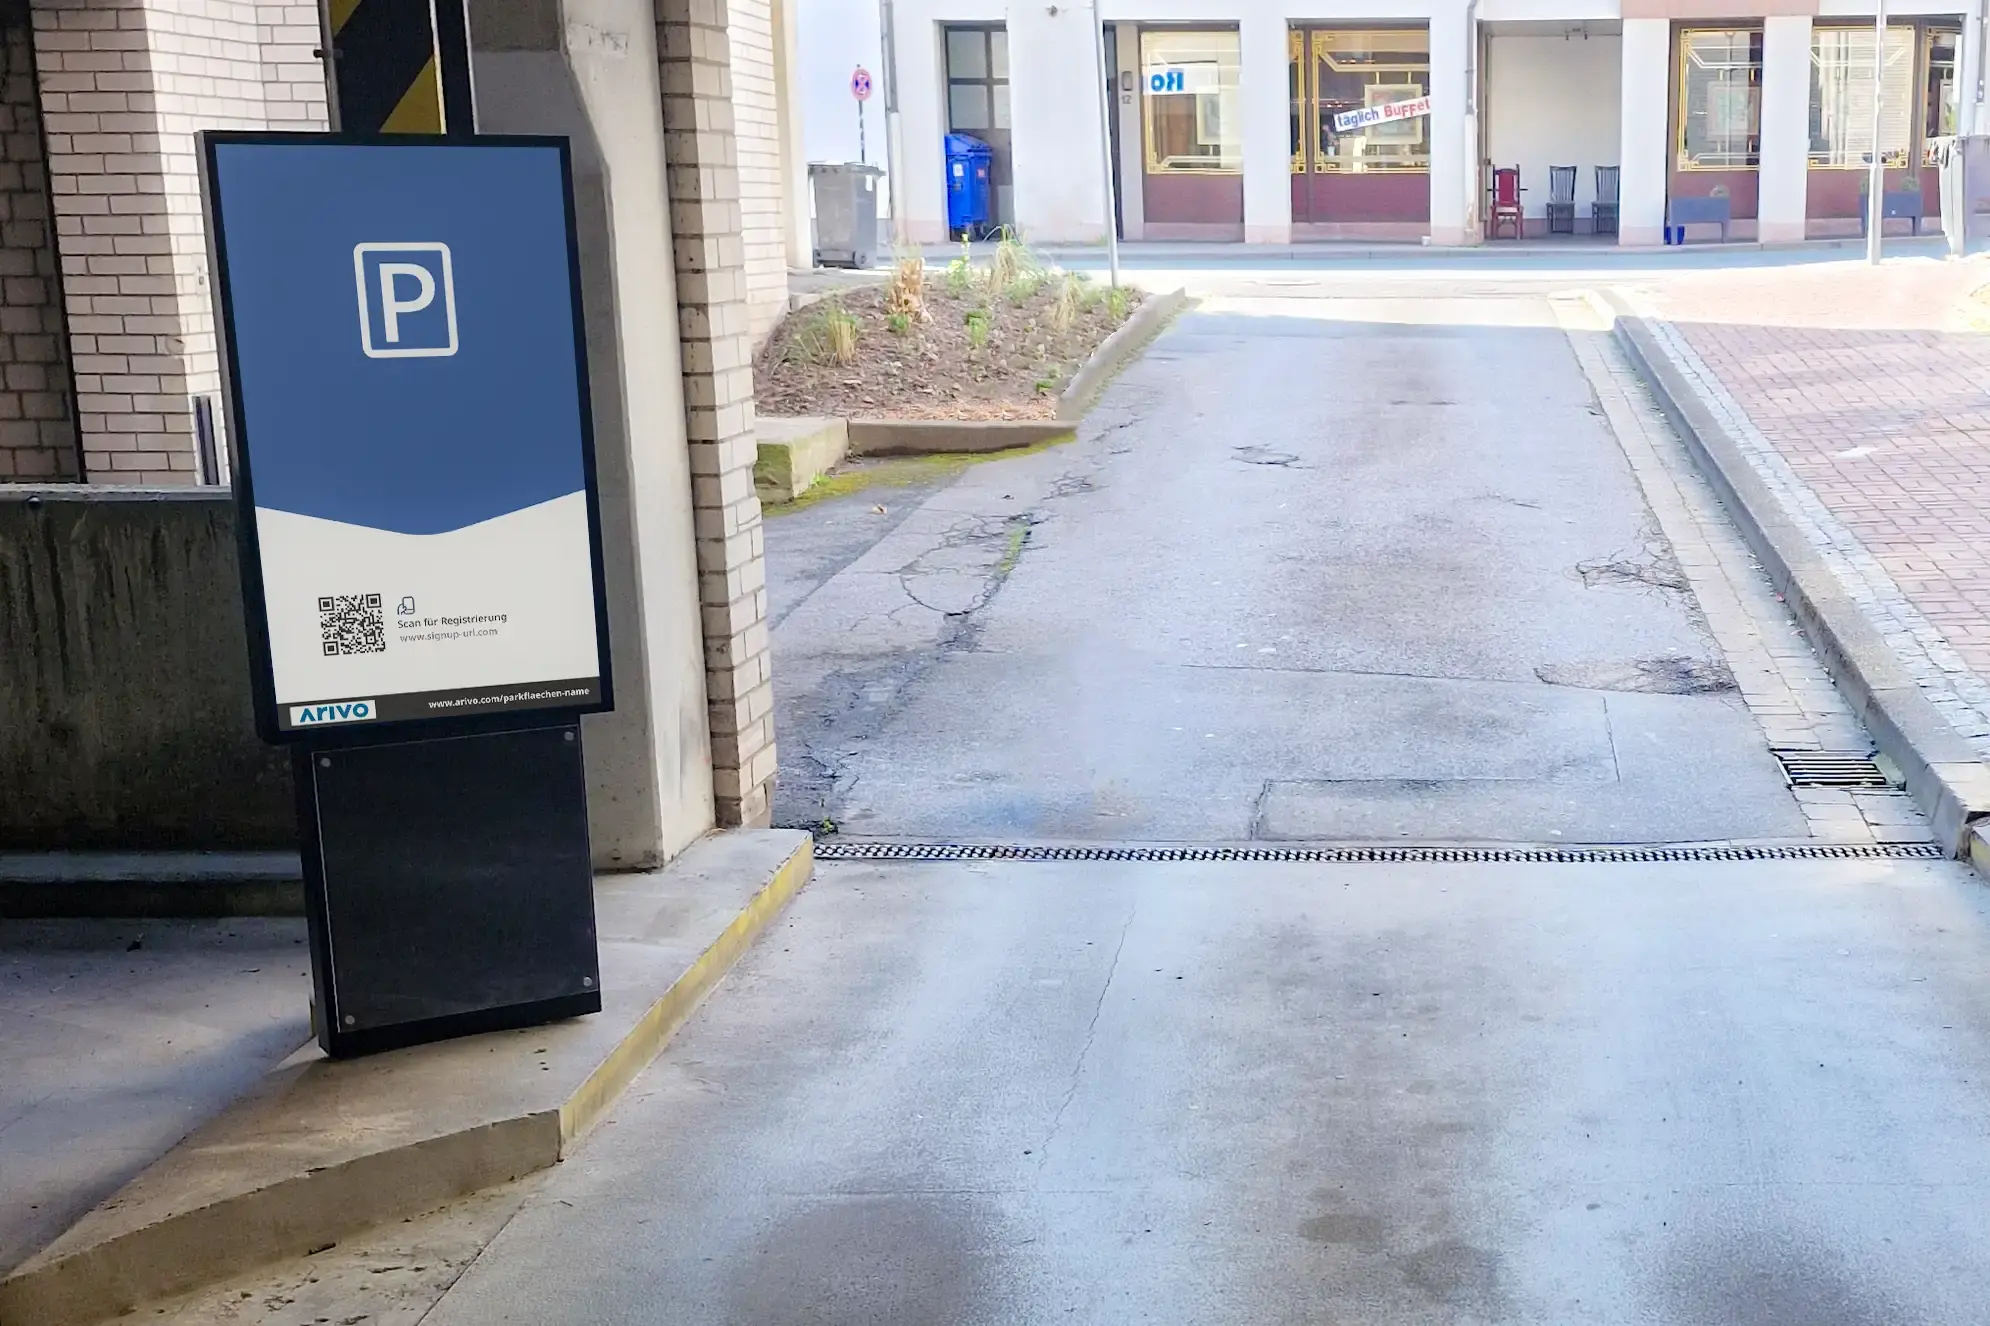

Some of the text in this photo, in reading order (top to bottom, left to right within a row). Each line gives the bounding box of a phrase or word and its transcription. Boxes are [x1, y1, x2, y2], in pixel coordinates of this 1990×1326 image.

[379, 263, 435, 342] P
[397, 613, 507, 629] Scan für Registrierung
[400, 628, 498, 641] www.signup-url.com
[428, 687, 590, 709] www.arivo.com/parkflaechen-name
